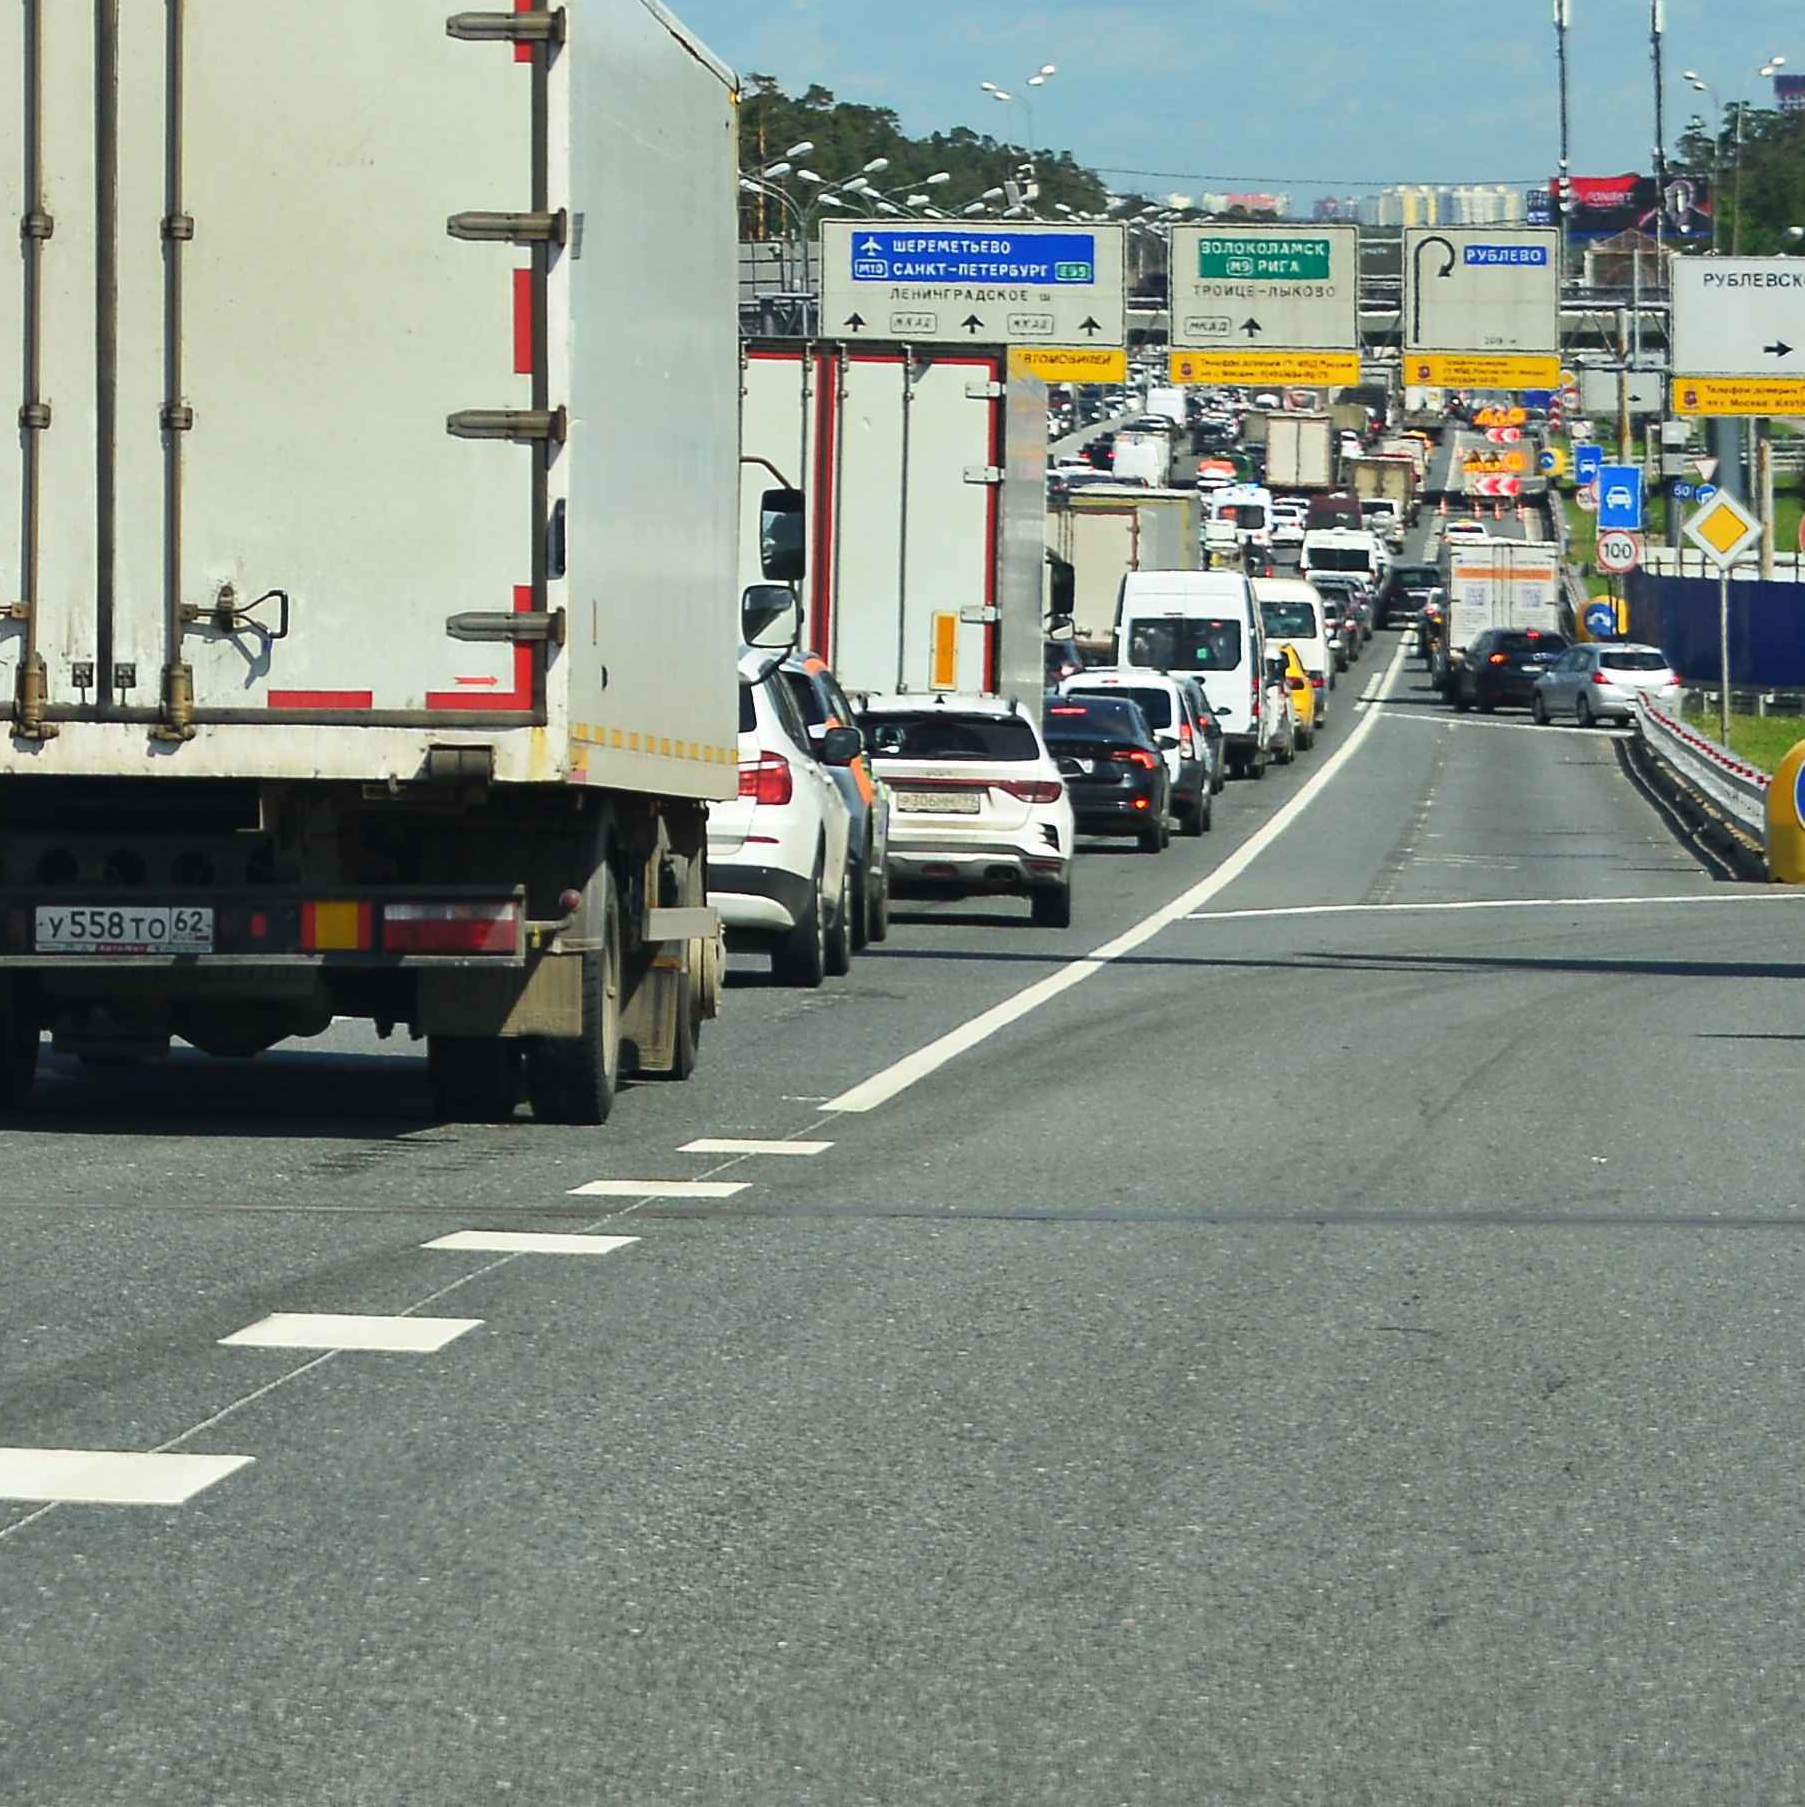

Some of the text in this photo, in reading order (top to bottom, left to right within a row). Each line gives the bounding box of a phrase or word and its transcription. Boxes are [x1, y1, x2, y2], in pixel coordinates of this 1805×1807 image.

[892, 240, 1011, 255] ШЕРЕМЕТЬЕВО
[1200, 241, 1325, 257] ВОЛОКОЛАМСК
[1466, 249, 1542, 262] РУБЛЕВО
[892, 262, 1049, 278] САНКТ-ПЕТЕРБУРГ
[1257, 259, 1301, 273] РИГА
[1703, 272, 1805, 287] РУБЛЕВСК
[889, 287, 1029, 302] ЛЕНИНГРАДСКОЕ
[1193, 284, 1336, 299] ТРОИЦЕ-ЛЫКОВО
[1017, 352, 1112, 365] ВТОМОБИЛЕЙ
[1604, 543, 1633, 559] 100
[48, 910, 204, 940] У558ТО 62
